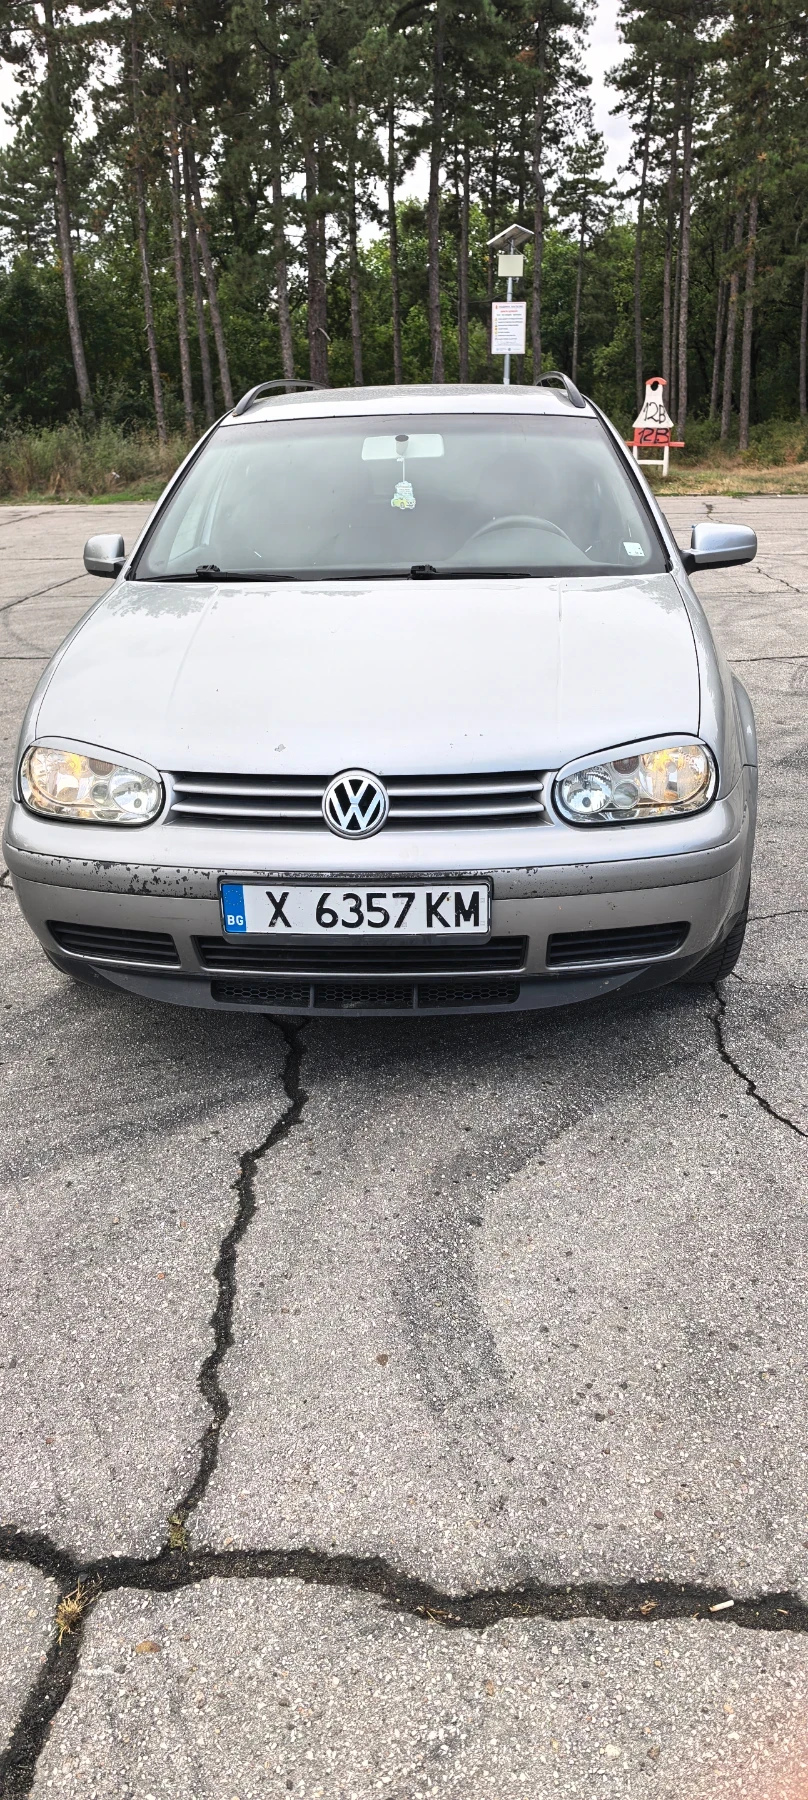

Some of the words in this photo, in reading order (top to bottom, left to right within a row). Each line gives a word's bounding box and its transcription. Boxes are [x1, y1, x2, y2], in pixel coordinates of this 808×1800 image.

[326, 775, 385, 832] VW
[227, 914, 244, 926] BG
[315, 892, 416, 928] 6357
